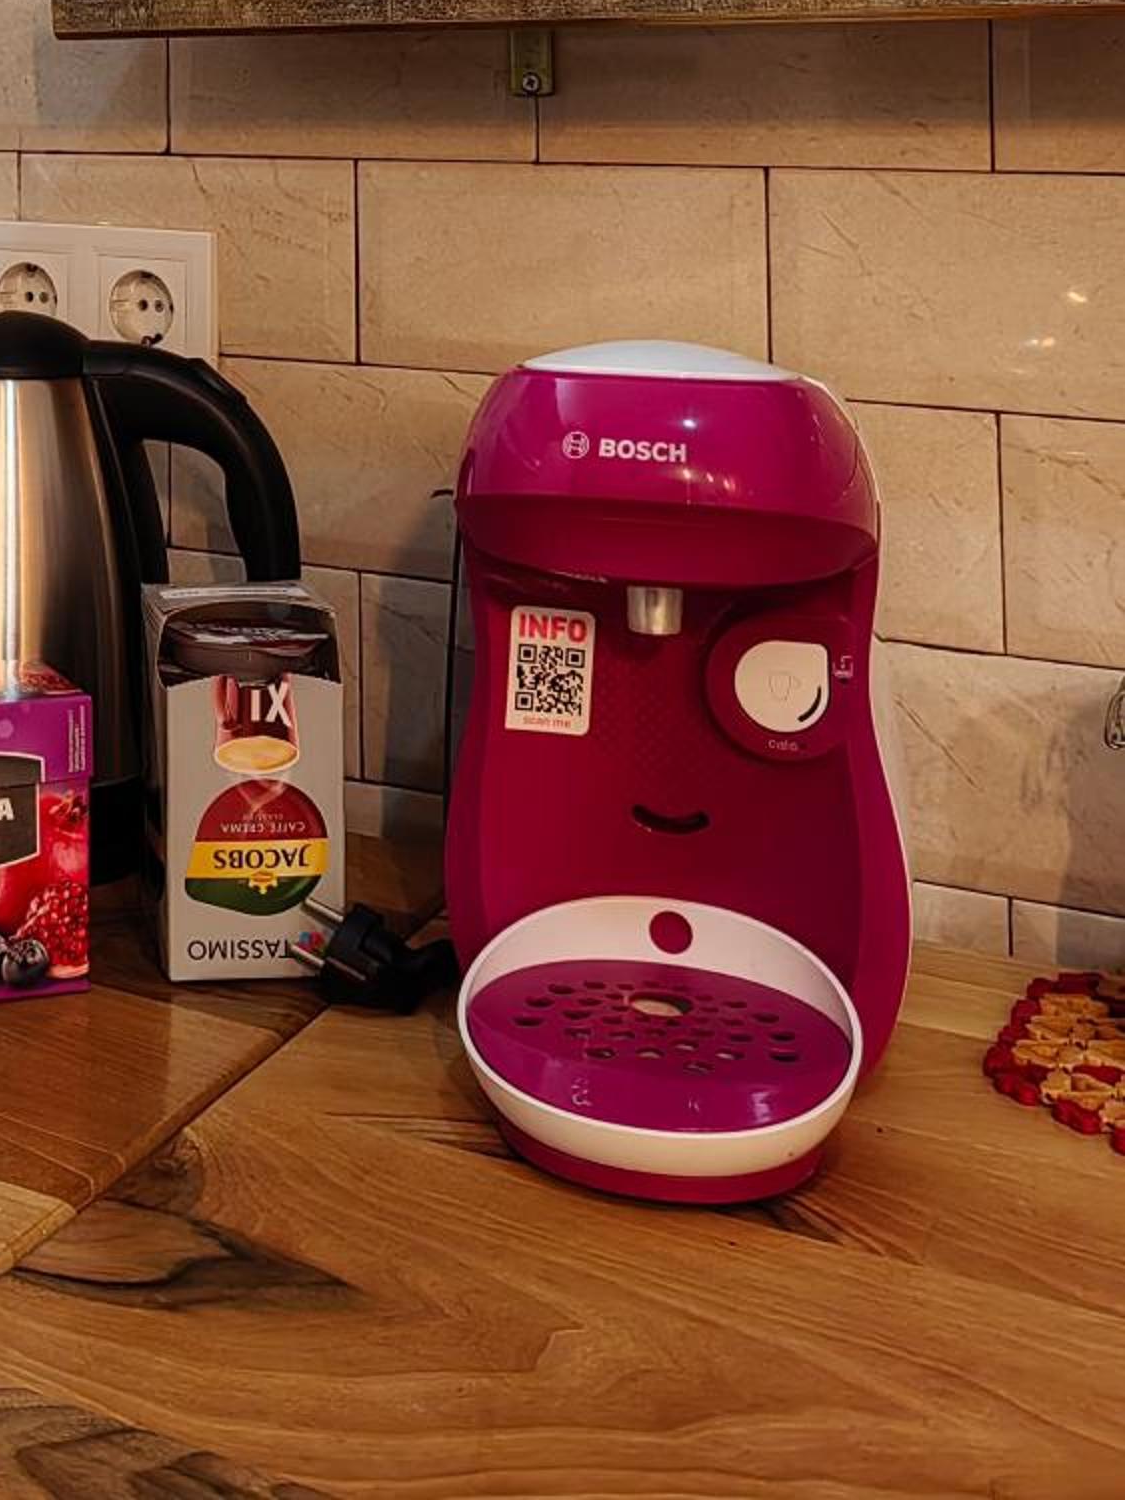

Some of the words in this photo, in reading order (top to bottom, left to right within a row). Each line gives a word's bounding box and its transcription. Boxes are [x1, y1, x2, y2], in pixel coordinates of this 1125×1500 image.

[598, 438, 687, 463] BOSCH
[519, 612, 587, 642] INFO
[212, 844, 312, 869] JACOBS
[187, 939, 294, 961] TASSIMO
